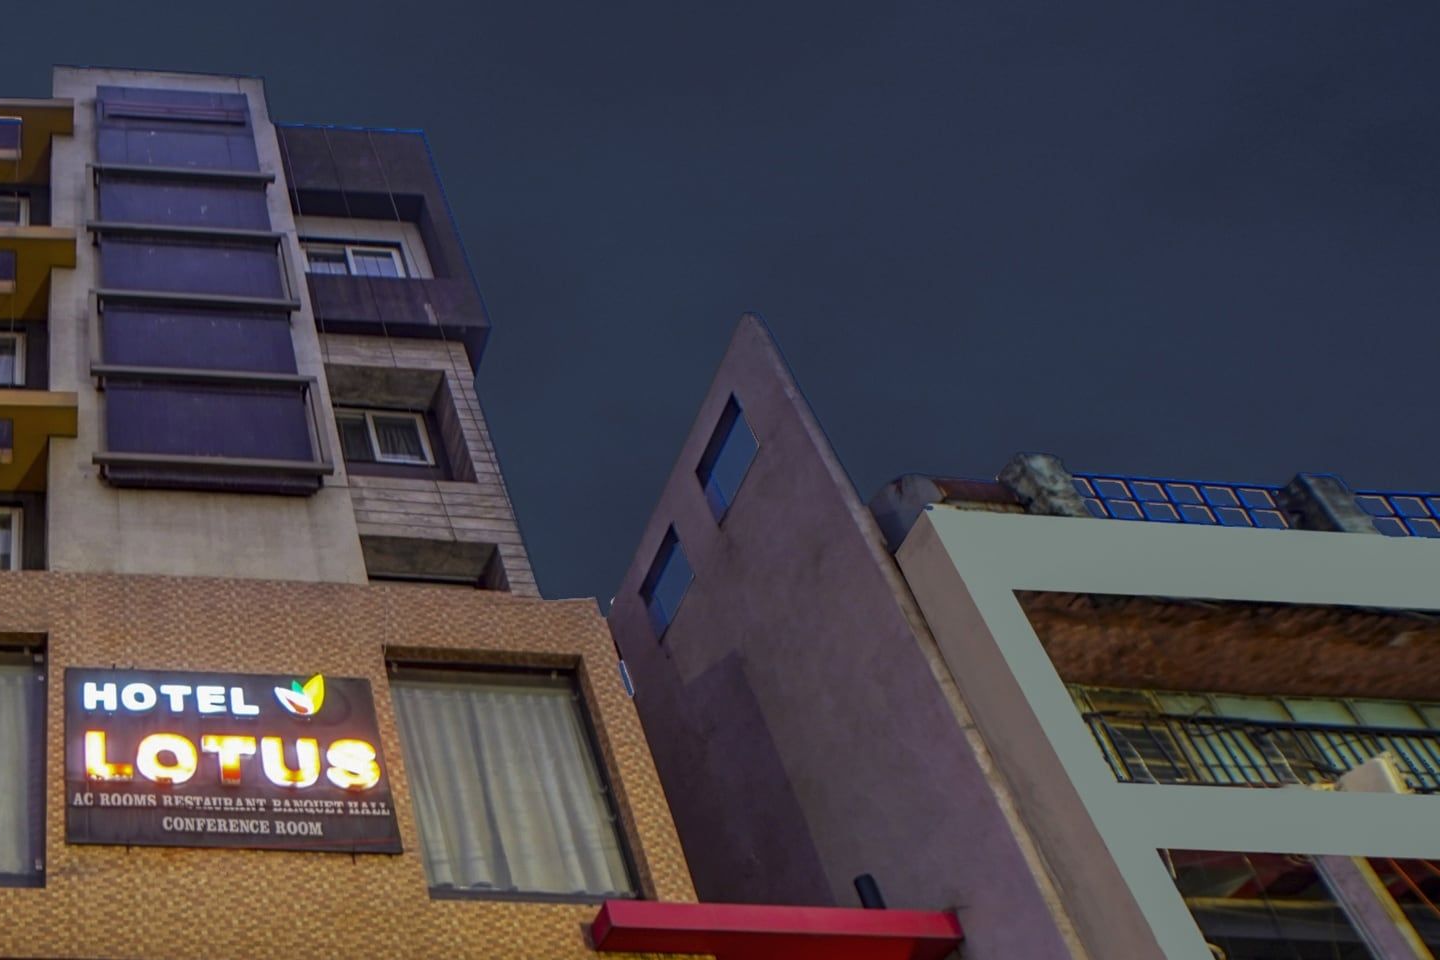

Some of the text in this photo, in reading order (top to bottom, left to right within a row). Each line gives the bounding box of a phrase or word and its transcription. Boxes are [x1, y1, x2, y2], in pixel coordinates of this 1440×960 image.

[83, 682, 259, 715] HOTEL
[84, 731, 381, 790] LOTUS
[73, 792, 390, 816] AC ROOMS RESTAURANT BANQUET HALL
[162, 816, 323, 836] CONFERENCE ROOM
